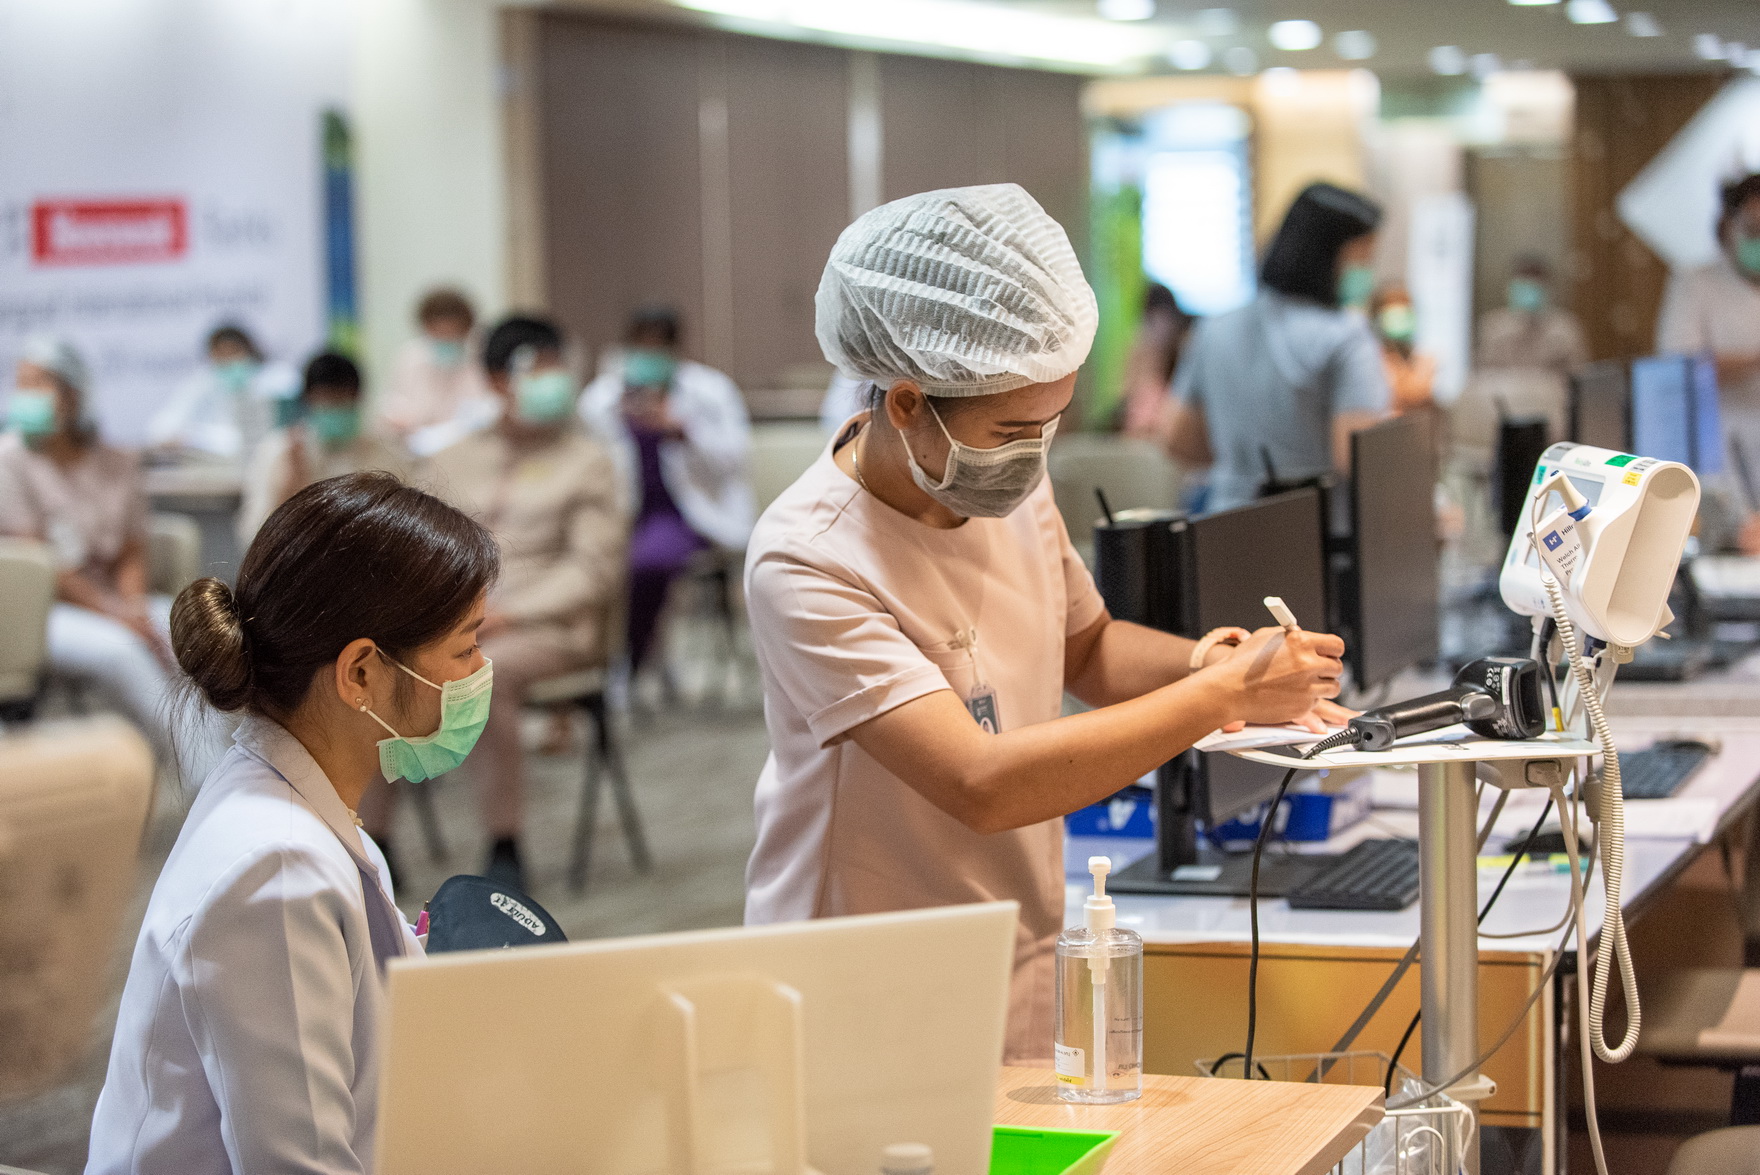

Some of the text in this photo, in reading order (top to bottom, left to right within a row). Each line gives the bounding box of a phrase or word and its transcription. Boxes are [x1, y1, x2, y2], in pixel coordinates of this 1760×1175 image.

[1561, 524, 1574, 536] Hillr
[1557, 549, 1575, 564] Welch
[507, 906, 540, 929] ADULT
